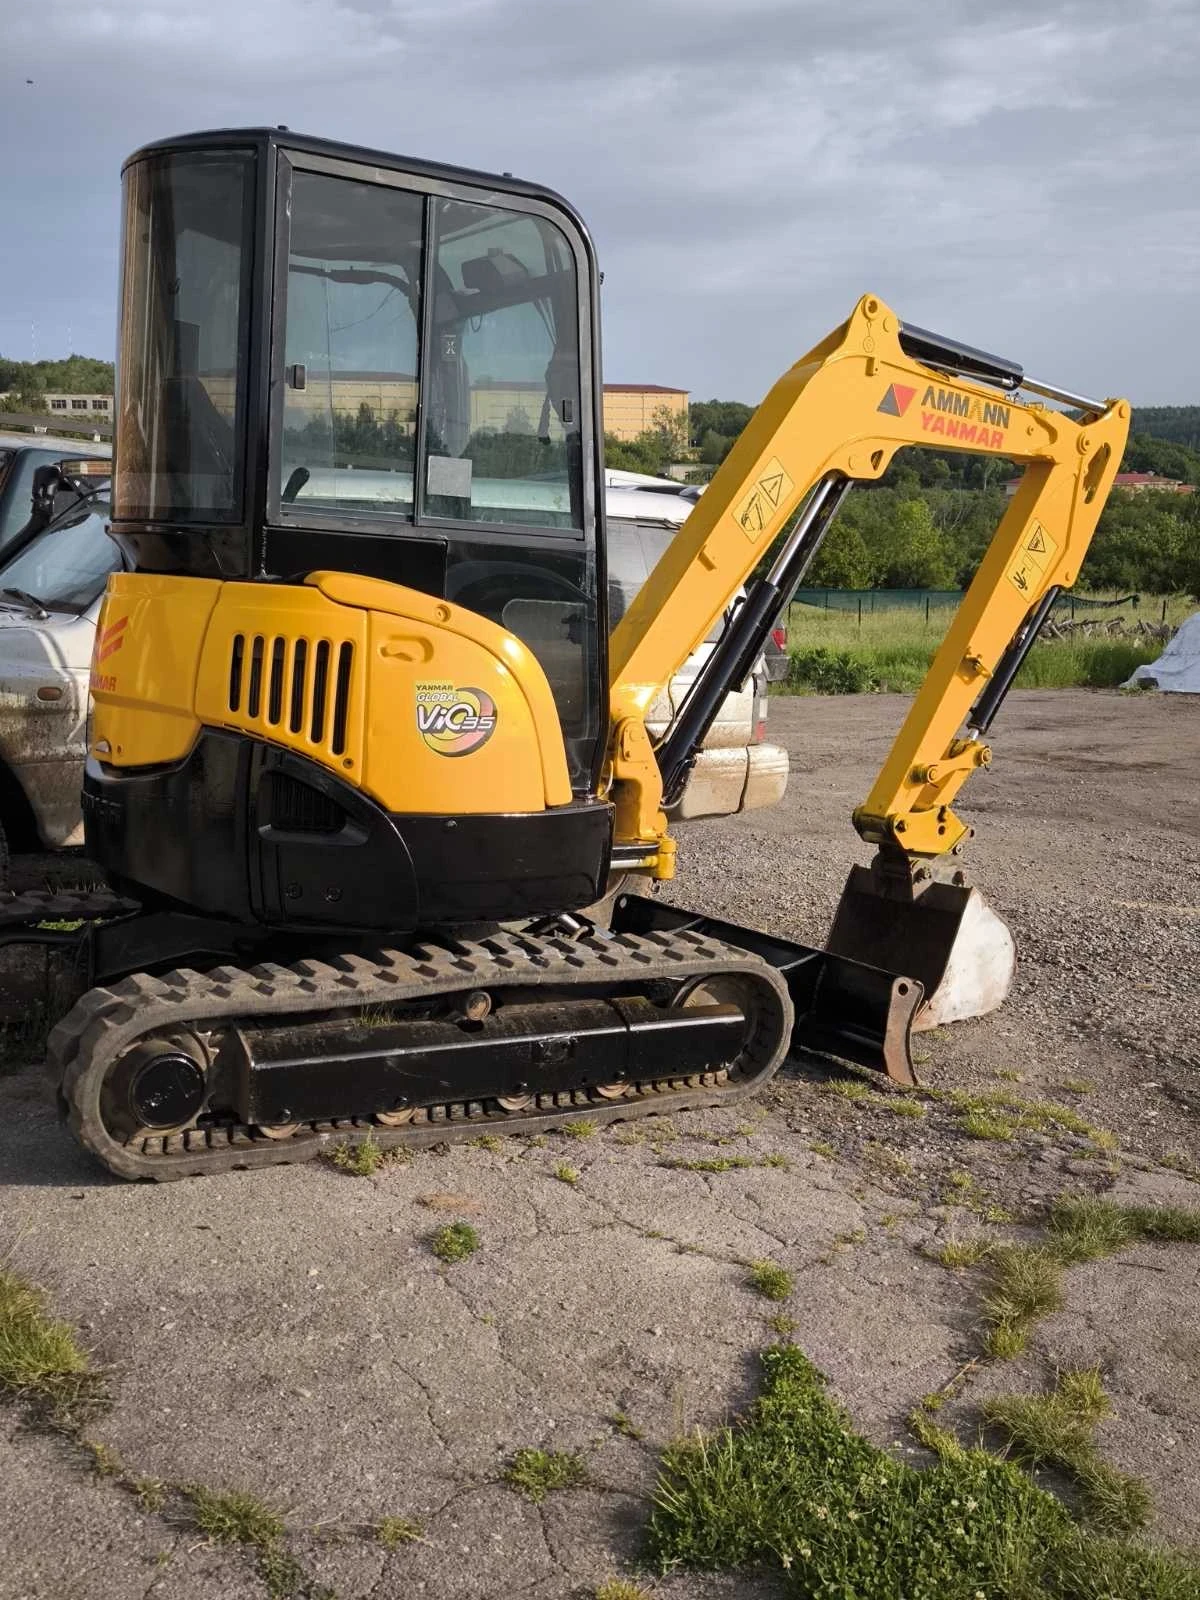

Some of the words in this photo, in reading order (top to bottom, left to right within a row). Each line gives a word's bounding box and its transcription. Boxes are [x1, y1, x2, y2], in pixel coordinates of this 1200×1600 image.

[921, 385, 1010, 429] AMMANN
[921, 412, 1004, 449] YANMAR
[417, 692, 458, 702] GLOBAL
